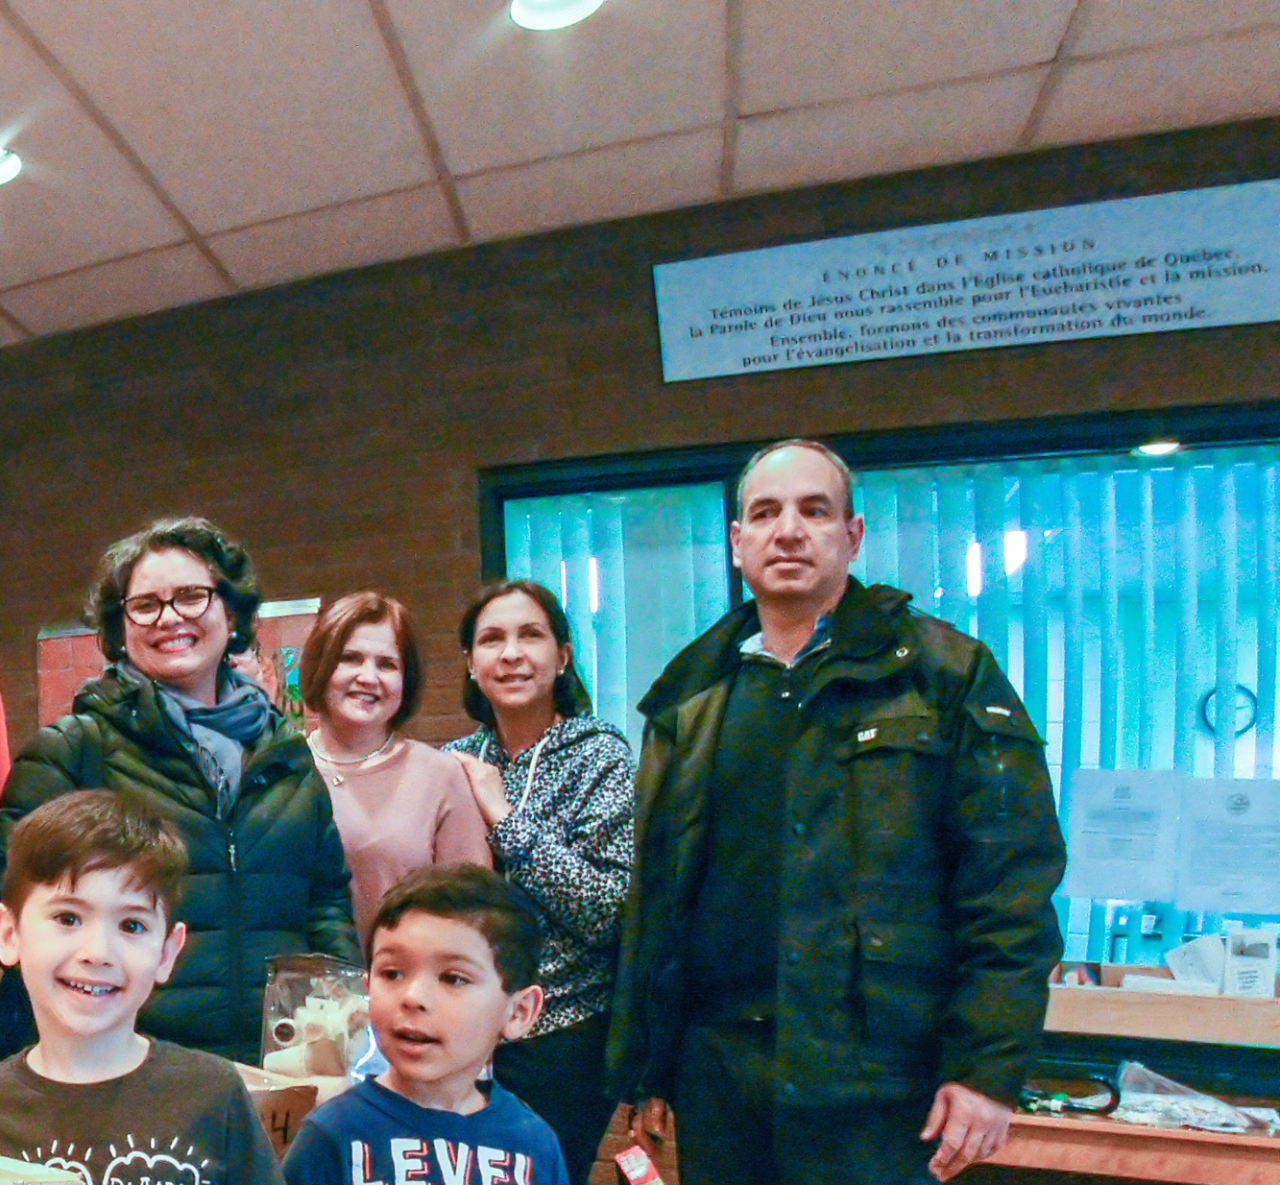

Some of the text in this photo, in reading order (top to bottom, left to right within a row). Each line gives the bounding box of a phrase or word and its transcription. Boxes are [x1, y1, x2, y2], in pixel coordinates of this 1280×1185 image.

[936, 253, 966, 270] DE
[983, 237, 1097, 263] MISSION
[689, 325, 703, 339] la
[709, 318, 758, 336] Parole
[764, 316, 784, 330] de
[789, 311, 827, 327] Dieu
[834, 305, 874, 321] nous
[880, 294, 965, 315] rassemble
[970, 289, 1011, 307] pour
[1139, 272, 1157, 287] et
[1164, 268, 1182, 284] la
[710, 301, 778, 320] Témoins
[783, 298, 803, 312] de
[858, 284, 910, 302] Christ
[916, 278, 956, 296] dans
[1032, 258, 1128, 282] catholique
[1134, 252, 1158, 270] de
[742, 351, 779, 369] pour
[922, 332, 940, 347] et
[946, 330, 963, 345] la
[969, 315, 1104, 343] transformation
[1110, 311, 1136, 328] du
[859, 319, 930, 337] formons
[936, 314, 967, 330] des
[1105, 291, 1183, 312] vivantes
[857, 727, 879, 743] CAT
